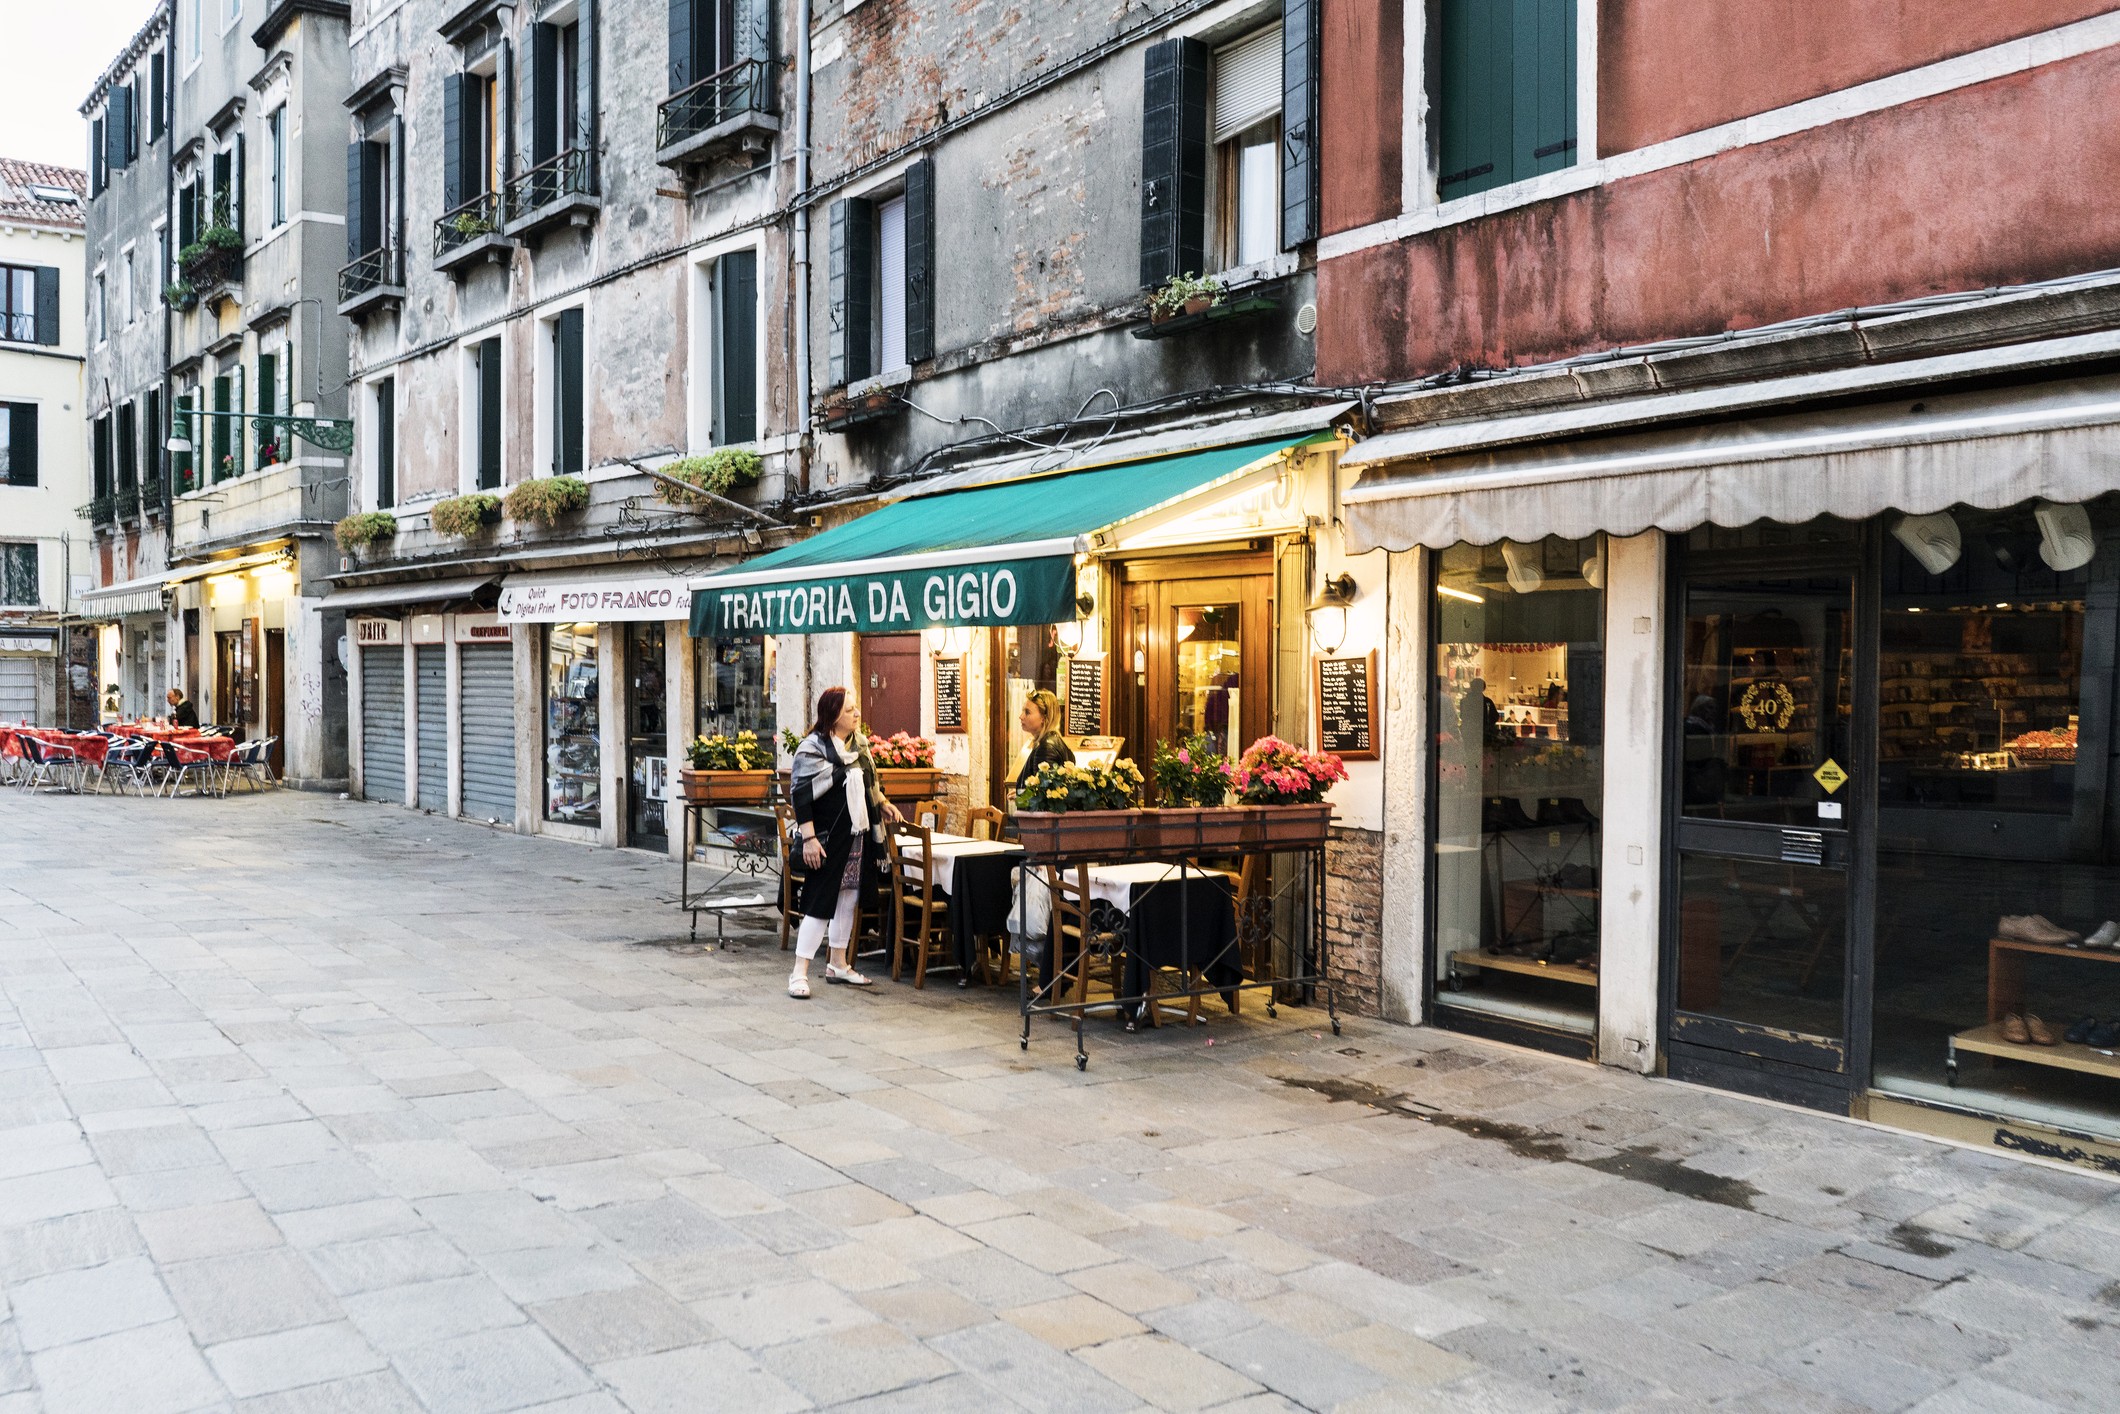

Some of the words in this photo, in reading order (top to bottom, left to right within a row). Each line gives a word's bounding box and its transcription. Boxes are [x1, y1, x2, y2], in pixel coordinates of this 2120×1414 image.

[528, 588, 547, 599] Quick
[560, 592, 598, 610] FOTO
[601, 589, 672, 609] FRANCO
[719, 584, 857, 630] TRATTORIA
[868, 579, 911, 623] DA
[923, 569, 1017, 621] GIGIO
[515, 603, 537, 618] Digital
[537, 602, 556, 614] Print
